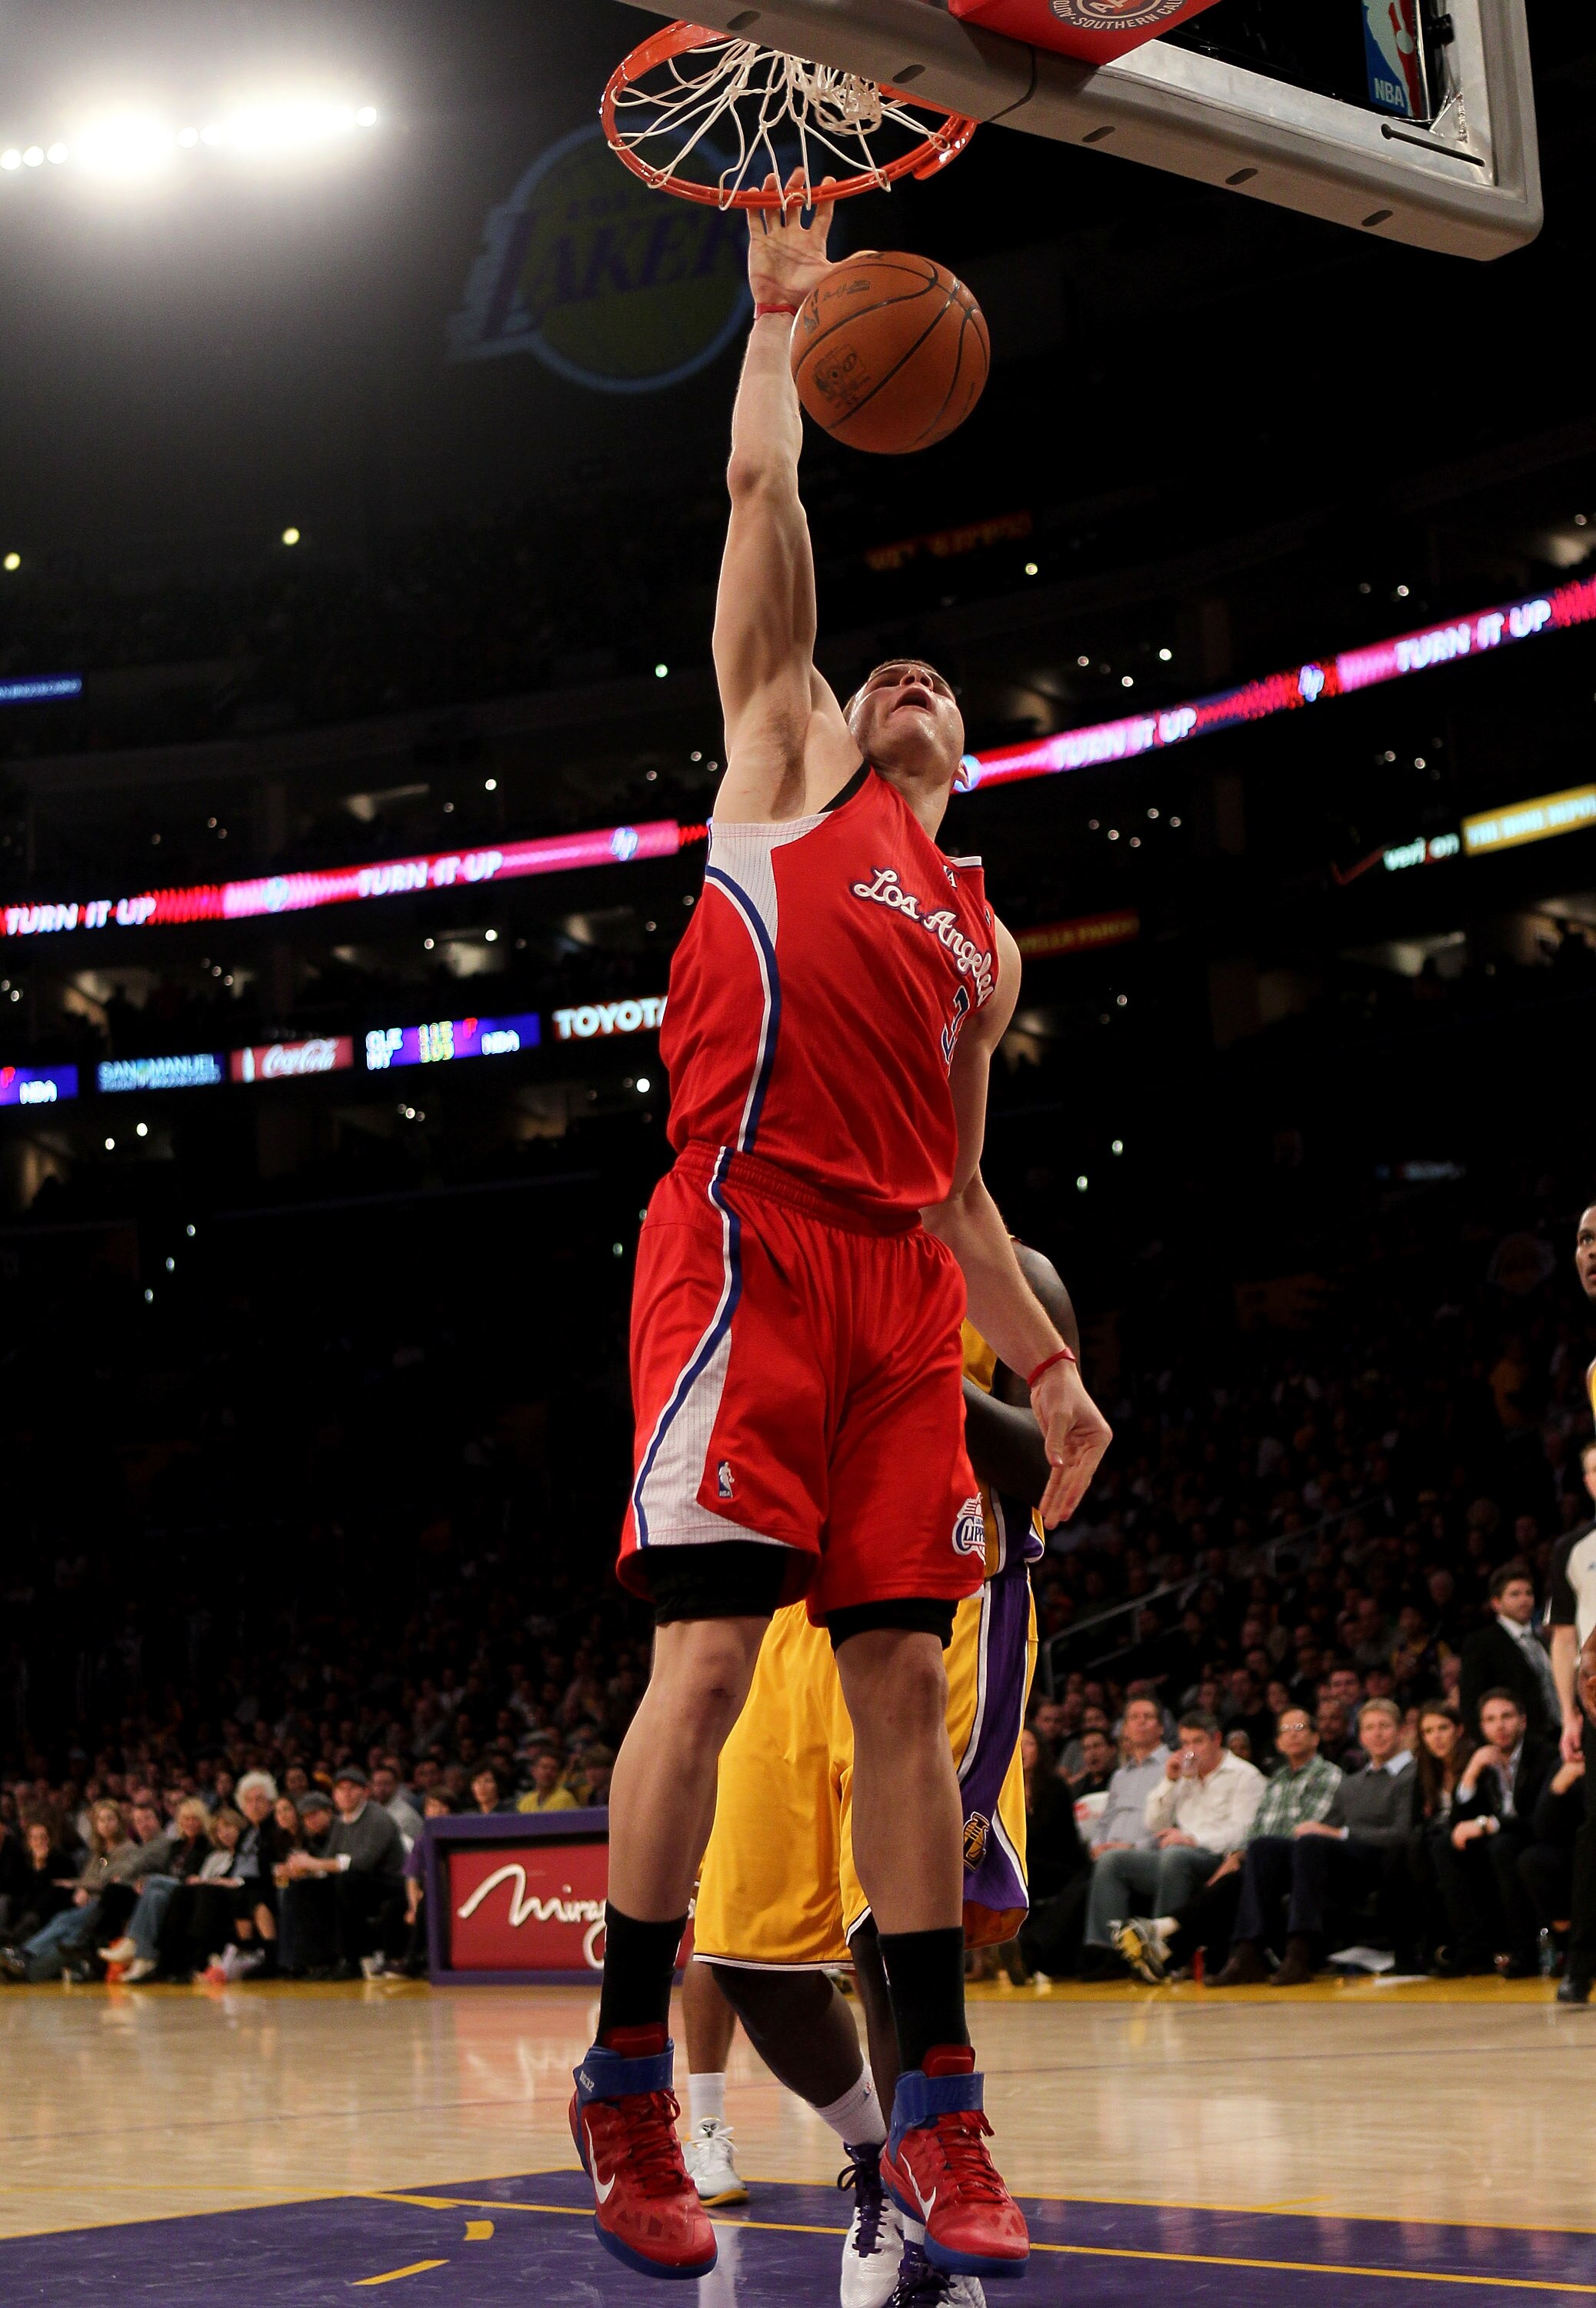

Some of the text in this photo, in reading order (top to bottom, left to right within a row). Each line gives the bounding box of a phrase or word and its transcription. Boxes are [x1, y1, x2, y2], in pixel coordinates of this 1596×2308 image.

[1073, 14, 1160, 29] SOUTHERN
[1374, 78, 1405, 108] NBA
[1394, 599, 1552, 672] TURN IT UP
[1158, 706, 1198, 744] UP
[356, 850, 505, 898] TURN IT UP
[5, 896, 158, 936] TURN IT UP
[853, 869, 921, 919] Los
[923, 910, 994, 1008] Angeles
